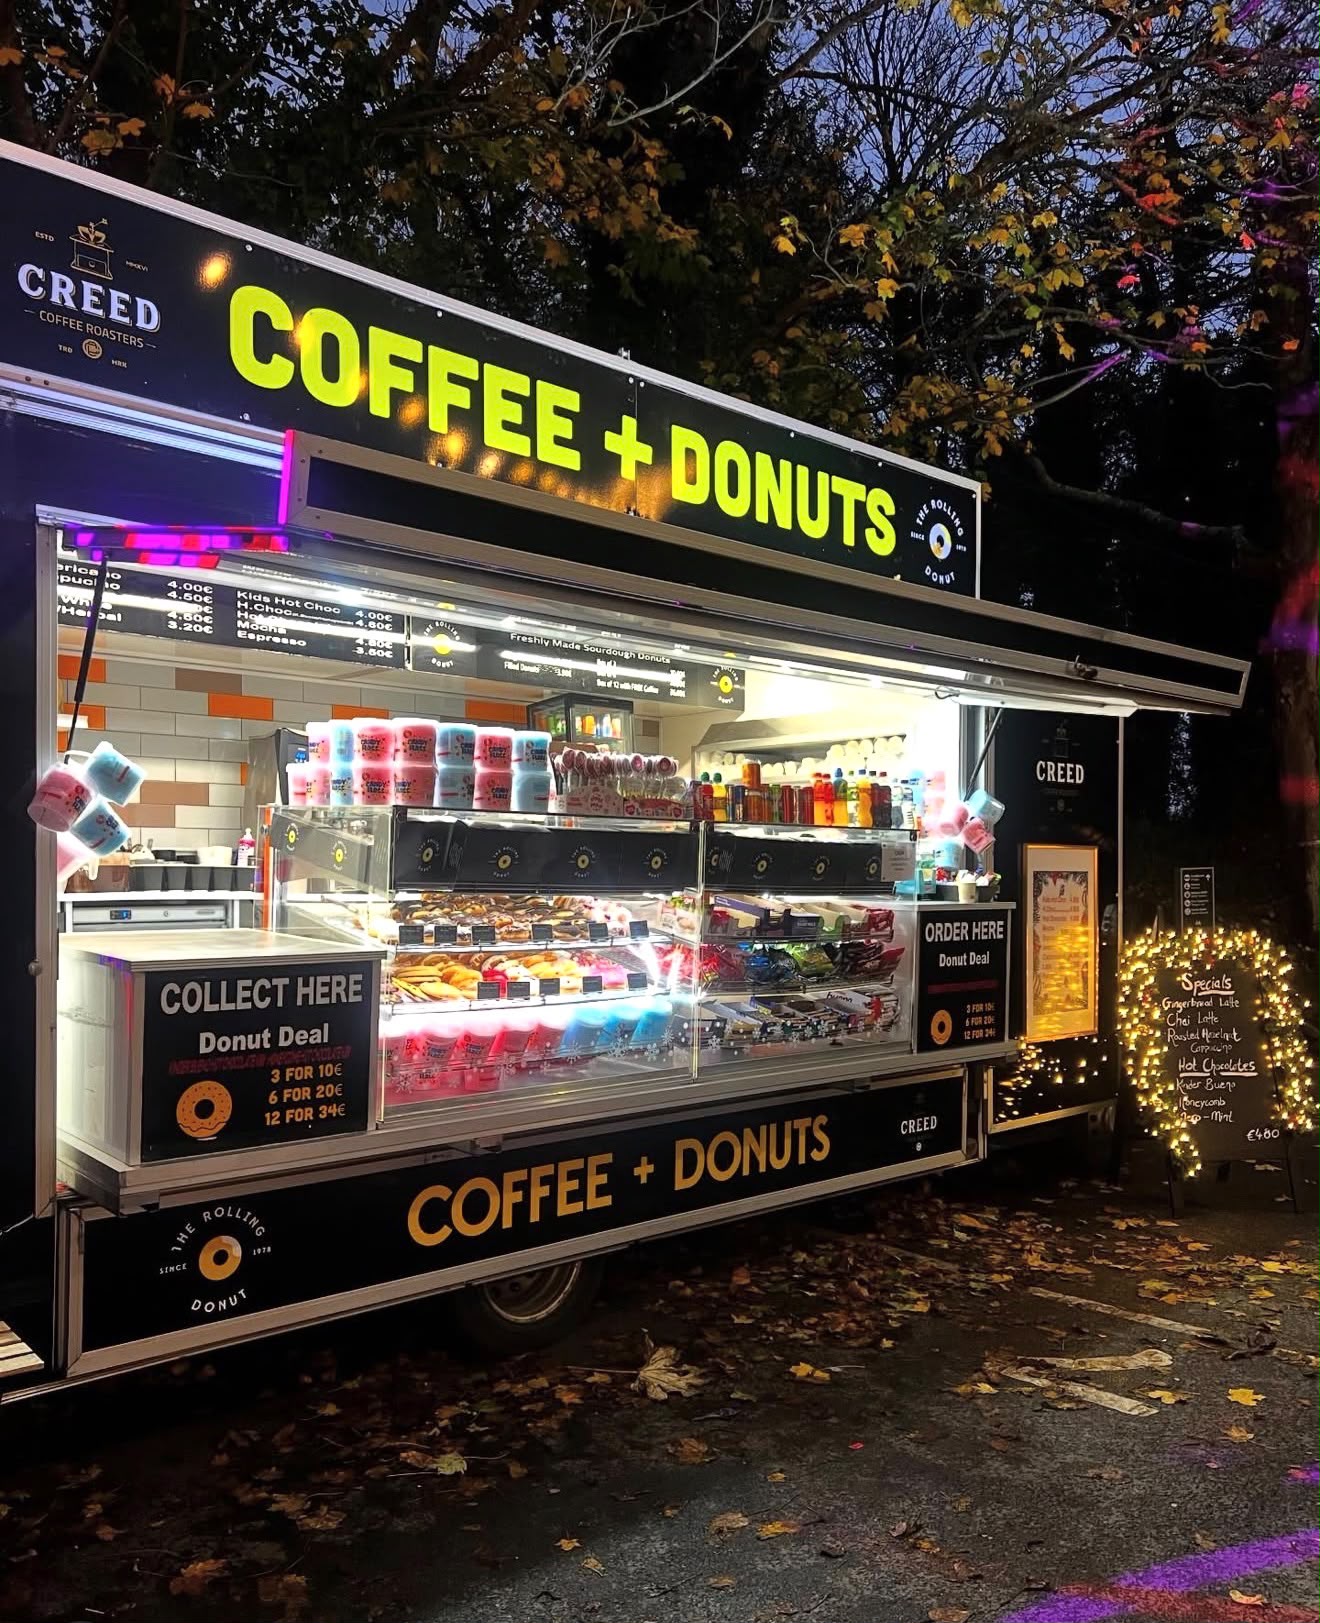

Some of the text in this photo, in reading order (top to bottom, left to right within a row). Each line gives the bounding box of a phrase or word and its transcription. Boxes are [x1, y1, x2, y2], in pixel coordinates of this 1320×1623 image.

[35, 231, 55, 242] ESTD
[17, 263, 161, 333] CREED
[39, 309, 145, 349] COFFEE ROASTERS
[229, 285, 897, 557] COFFEE + DONUTS
[916, 499, 964, 537] THE ROLLING
[924, 565, 955, 585] DONUT
[167, 580, 213, 594] 4.00€
[167, 590, 213, 604] 4.50€
[236, 590, 270, 603] Kids
[274, 594, 301, 608] Hot
[303, 601, 341, 614] Choc
[355, 610, 393, 622] 4.00€
[167, 620, 213, 634] 3.20€
[236, 620, 287, 635] Mocha
[236, 630, 307, 647] Espresso
[510, 632, 671, 664] Freshly Made Sourdough Donuts
[1036, 760, 1084, 784] CREED
[925, 921, 1004, 942] ORDER HERE
[939, 951, 990, 967] Donut Deal
[160, 973, 363, 1015] COLLECT HERE
[1181, 972, 1232, 997] Specials
[972, 1003, 984, 1013] FOR
[1219, 997, 1240, 1008] Latte
[971, 1016, 983, 1026] FOR
[1166, 1011, 1219, 1027] Chai Latte
[199, 1023, 329, 1054] Donut Deal
[972, 1029, 984, 1039] FOR
[1167, 1028, 1200, 1047] Roasted
[270, 1063, 343, 1083] 3 FOR 10€
[1178, 1057, 1256, 1076] Hot Chocolates
[268, 1083, 343, 1104] 6 FOR 20€
[1176, 1078, 1236, 1094] Kinder Bueno
[1179, 1096, 1226, 1111] Honeycomb
[264, 1103, 347, 1126] 12 FOR 34€
[900, 1115, 937, 1134] CREED
[407, 1114, 831, 1247] COFFEE + DONUTS
[171, 1206, 266, 1251] THE ROLLING
[159, 1263, 187, 1275] SINCE
[191, 1288, 248, 1313] DONUT
